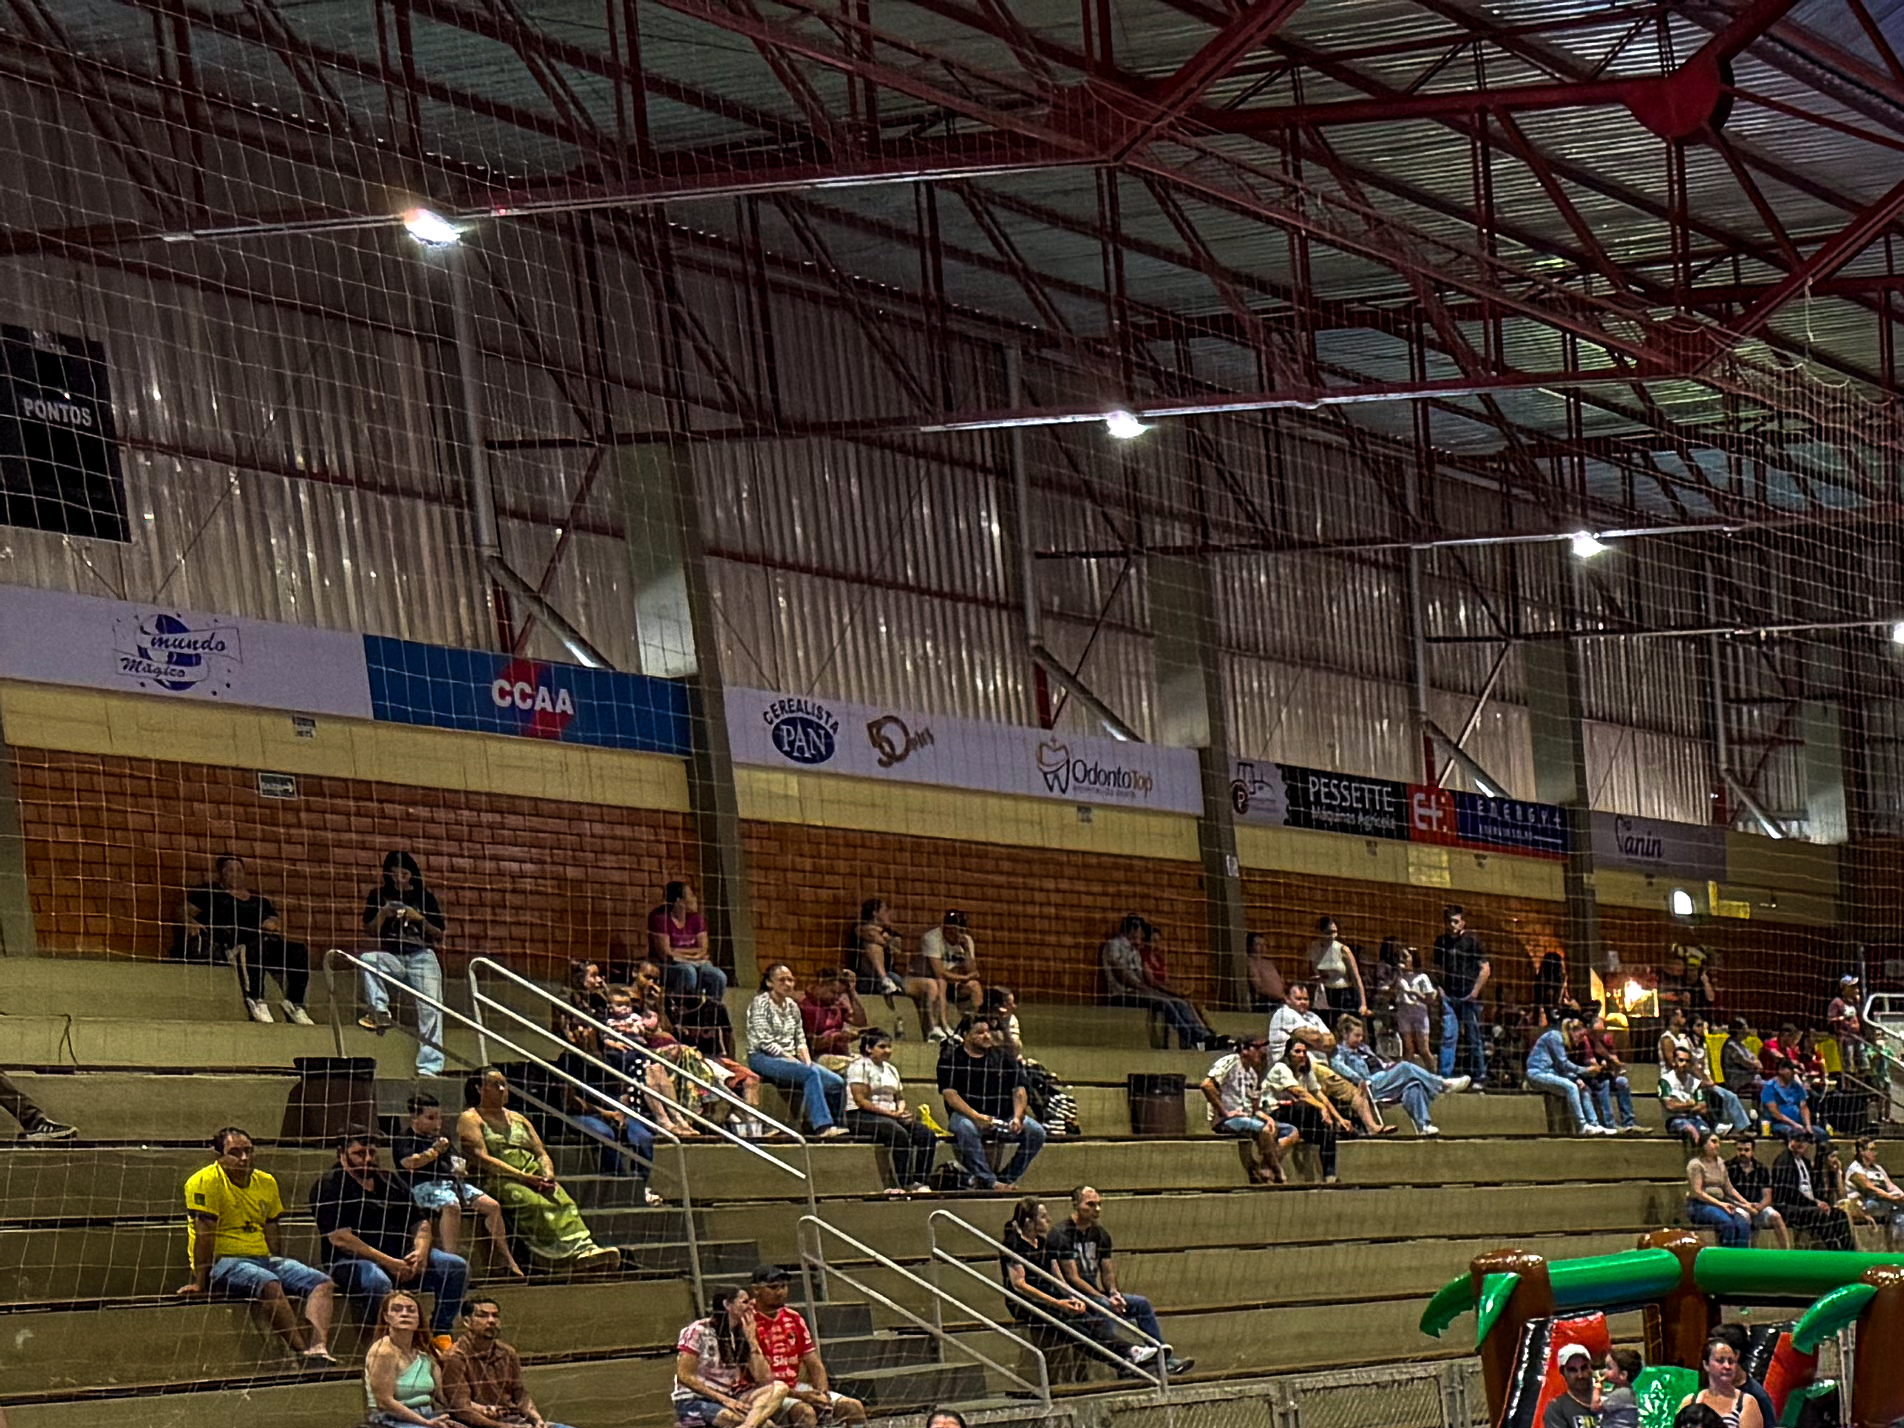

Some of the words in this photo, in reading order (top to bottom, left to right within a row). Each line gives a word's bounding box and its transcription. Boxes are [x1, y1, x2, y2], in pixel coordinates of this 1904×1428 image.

[23, 398, 92, 427] PONTOS
[151, 632, 226, 652] mundo
[492, 679, 574, 715] CCAA
[763, 698, 840, 735] CEREALISTA
[780, 718, 827, 758] PAN
[1072, 759, 1153, 798] OdontoTop
[1309, 776, 1394, 811] PESSETTE
